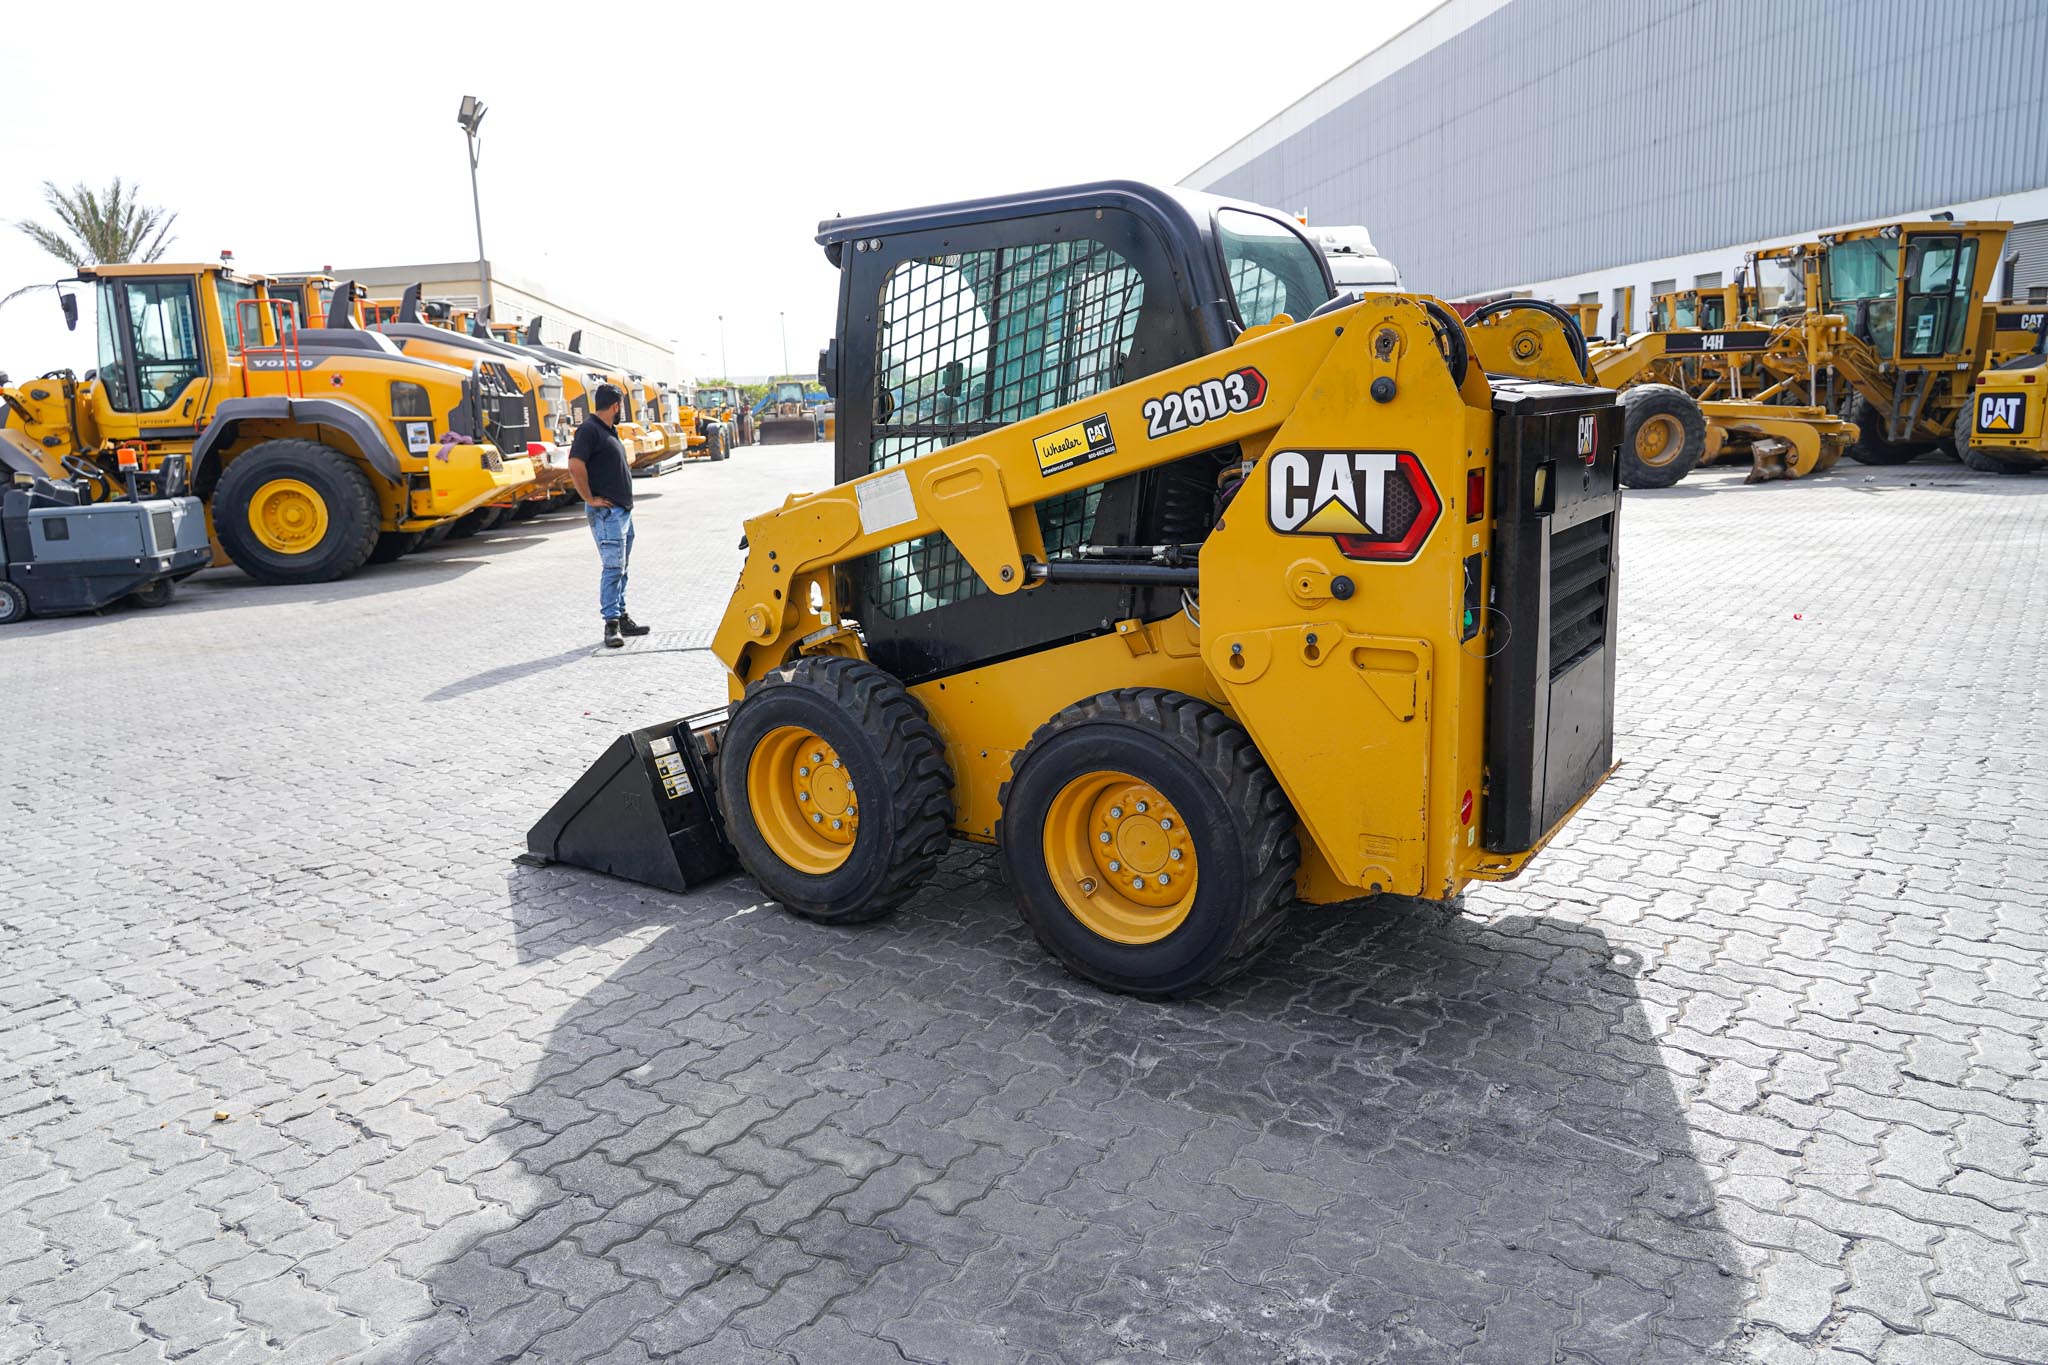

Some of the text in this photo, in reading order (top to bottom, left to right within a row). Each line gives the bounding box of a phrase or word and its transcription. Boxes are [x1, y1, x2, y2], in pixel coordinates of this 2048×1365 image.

[2021, 314, 2044, 329] CAT
[1701, 334, 1724, 350] 14H
[253, 359, 313, 367] VOLVO
[1144, 373, 1249, 437] 226D3
[1981, 397, 2021, 429] CAT
[1043, 423, 1107, 457] Wheeler CAT
[1578, 416, 1594, 455] CAT
[1270, 452, 1396, 534] CAT
